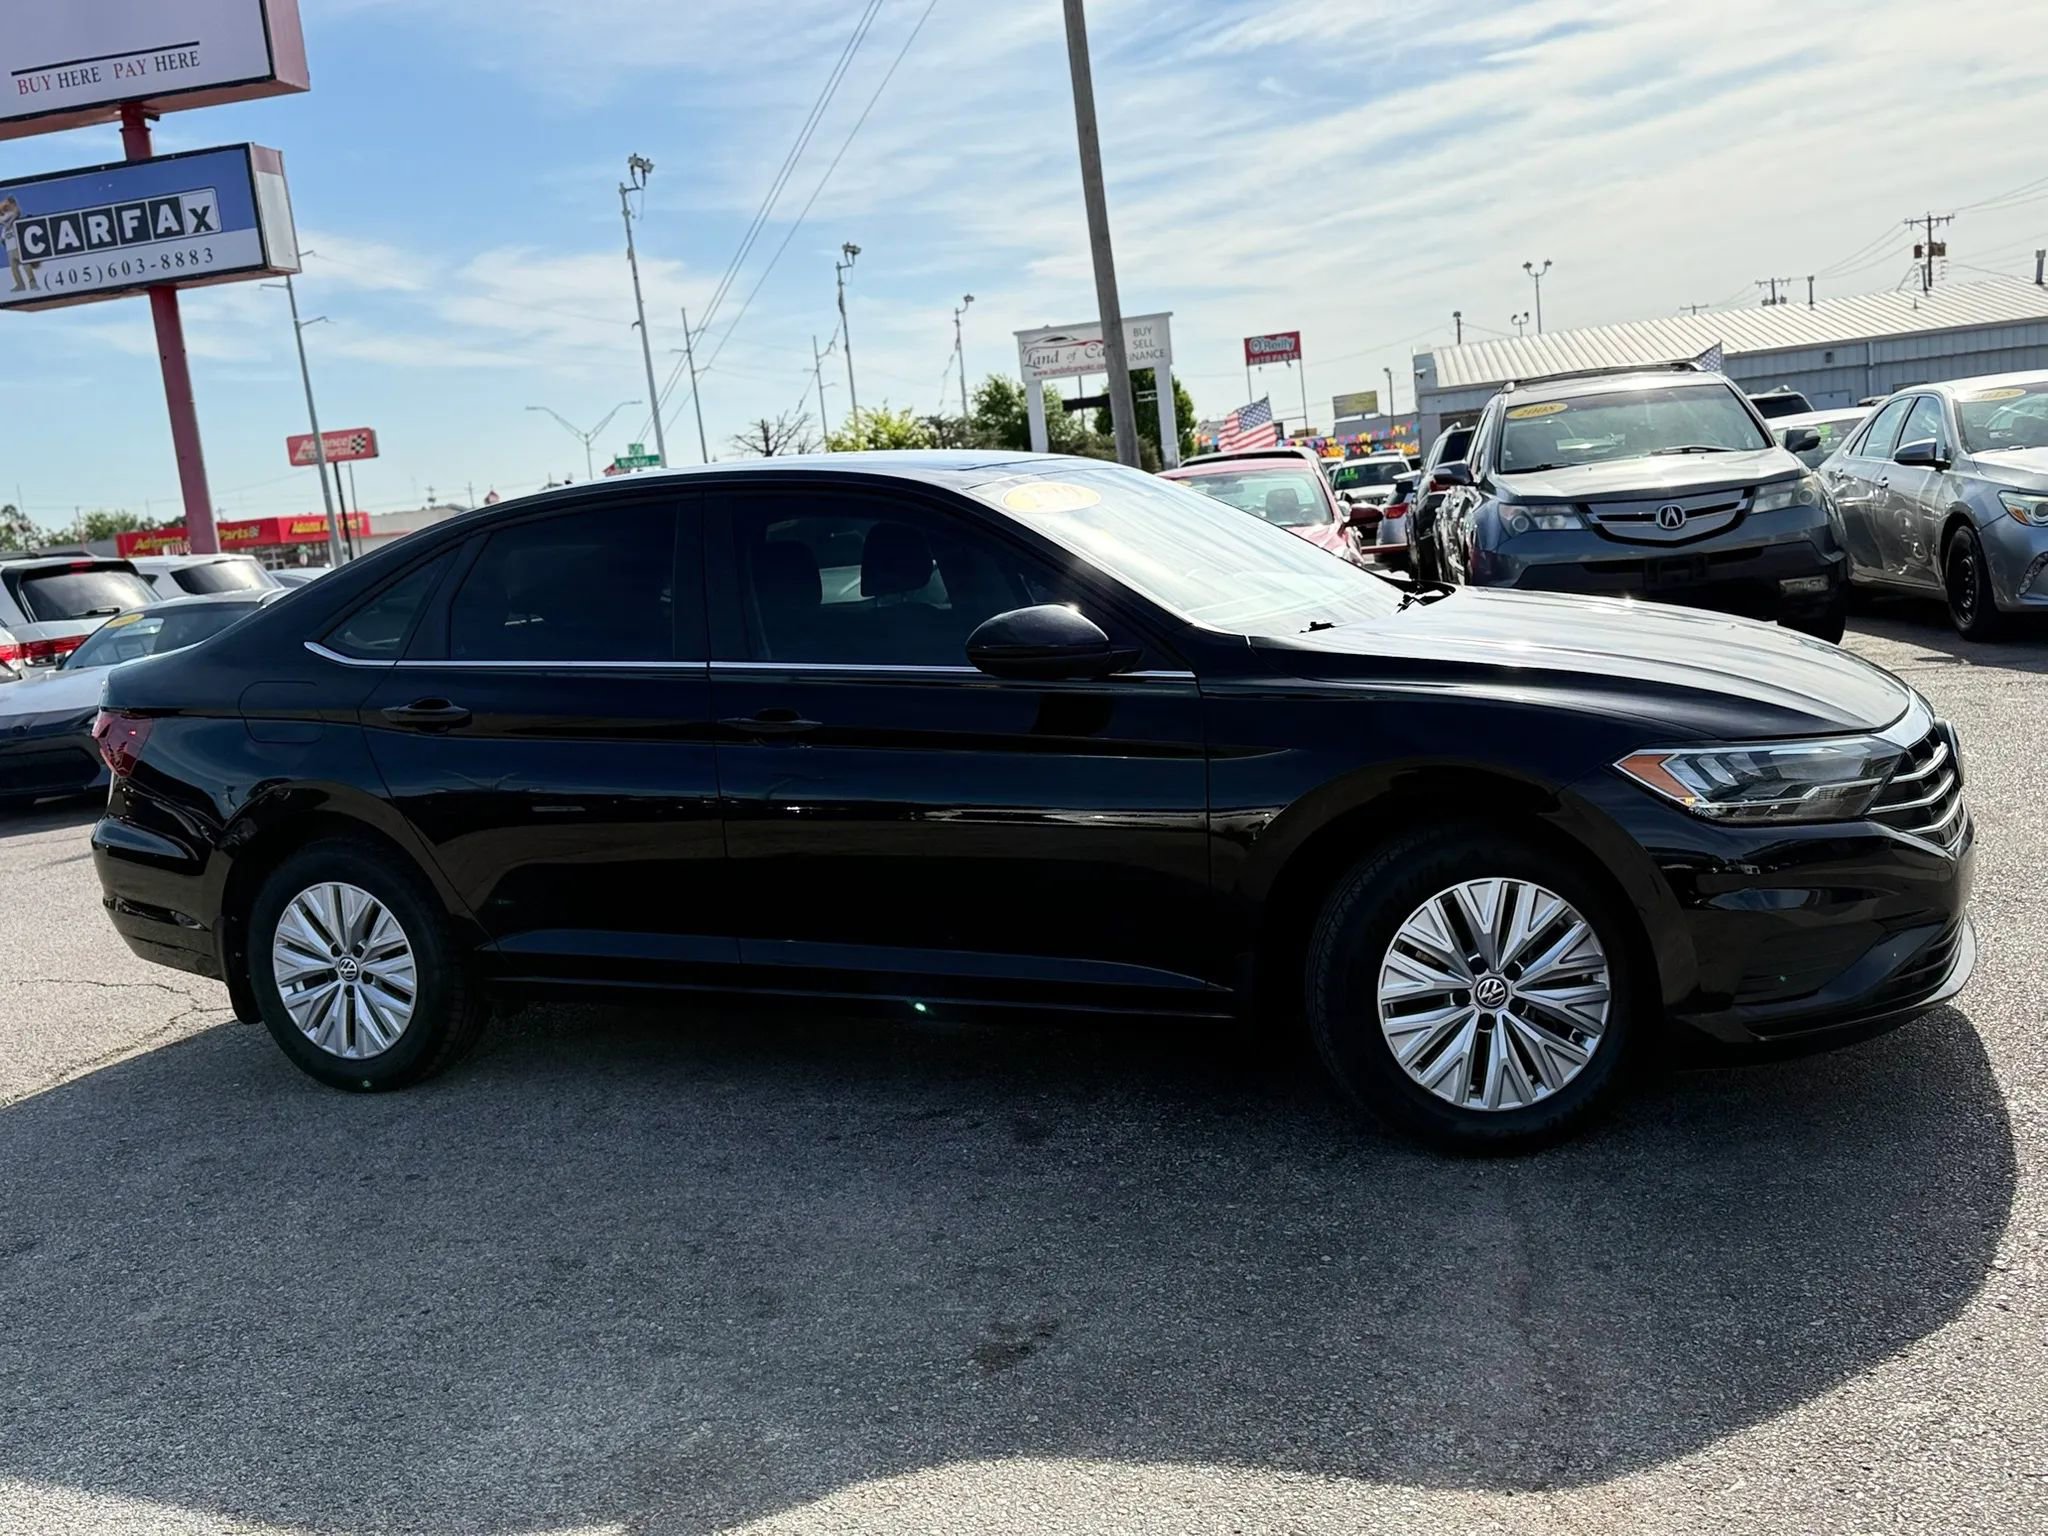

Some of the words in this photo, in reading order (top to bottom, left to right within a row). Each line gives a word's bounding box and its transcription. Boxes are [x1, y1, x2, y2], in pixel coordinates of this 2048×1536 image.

[17, 75, 52, 96] BUY
[58, 67, 102, 89] HERE
[112, 59, 147, 80] PAY
[154, 50, 200, 73] HERE
[23, 204, 215, 255] CARFAX
[44, 247, 214, 291] (405)603-8883
[1132, 341, 1154, 350] SELL
[1133, 327, 1152, 337] BUY
[1024, 350, 1059, 369] Land
[1067, 350, 1076, 364] of
